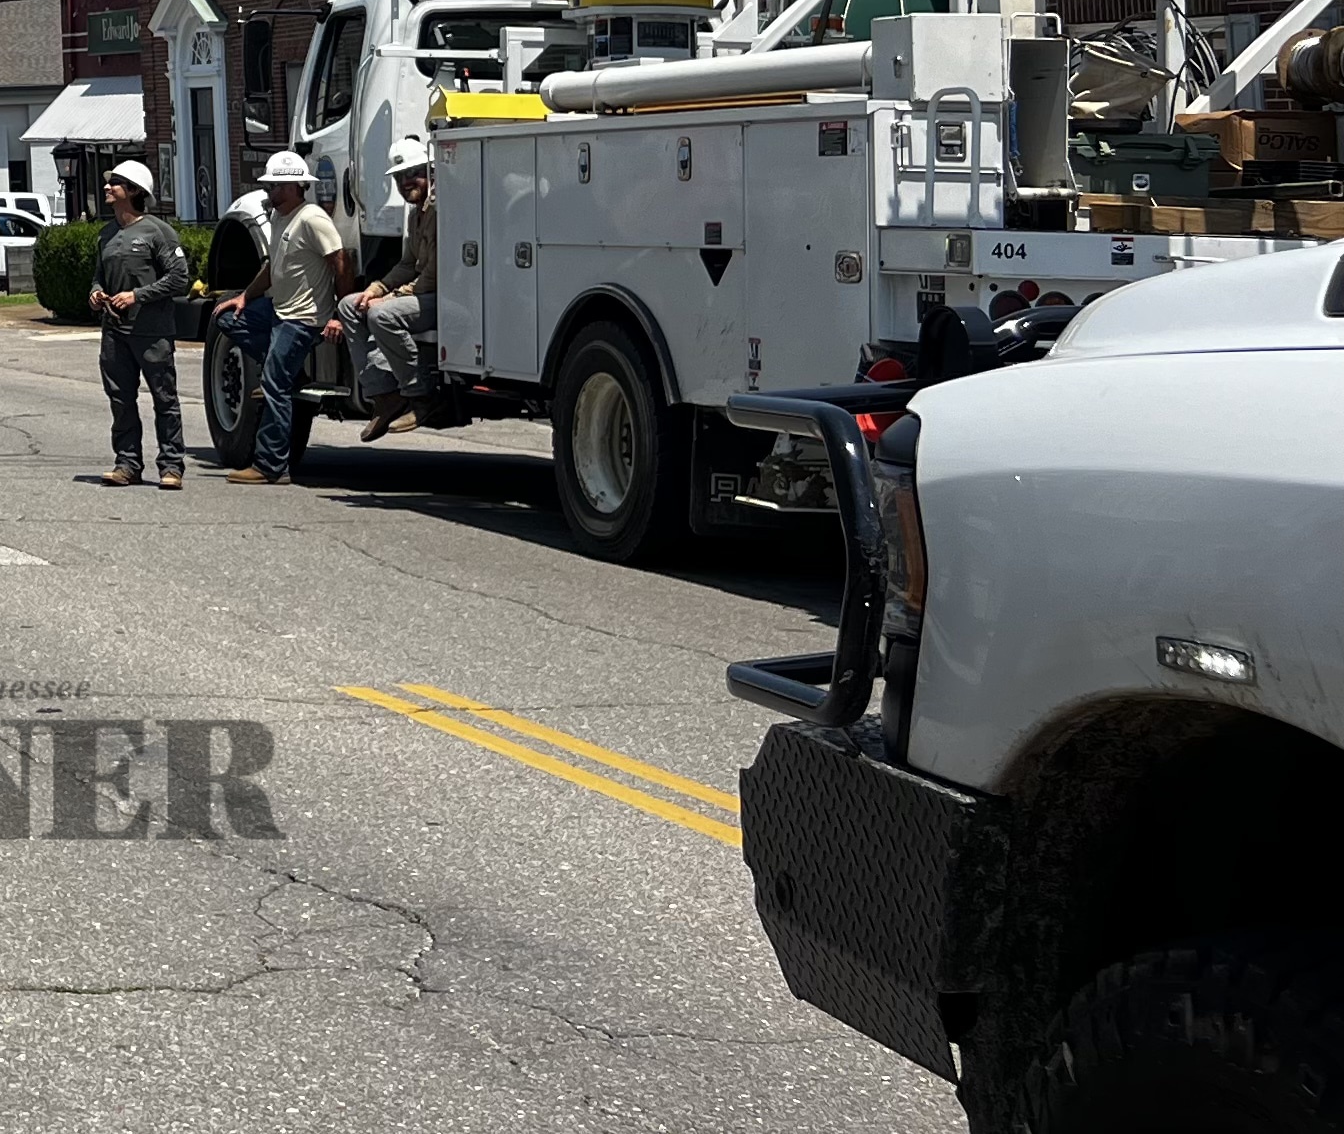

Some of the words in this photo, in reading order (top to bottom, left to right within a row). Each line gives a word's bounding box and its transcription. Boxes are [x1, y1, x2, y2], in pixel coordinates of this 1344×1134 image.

[102, 16, 130, 41] Edward
[130, 16, 141, 42] Jo
[991, 243, 1027, 260] 404
